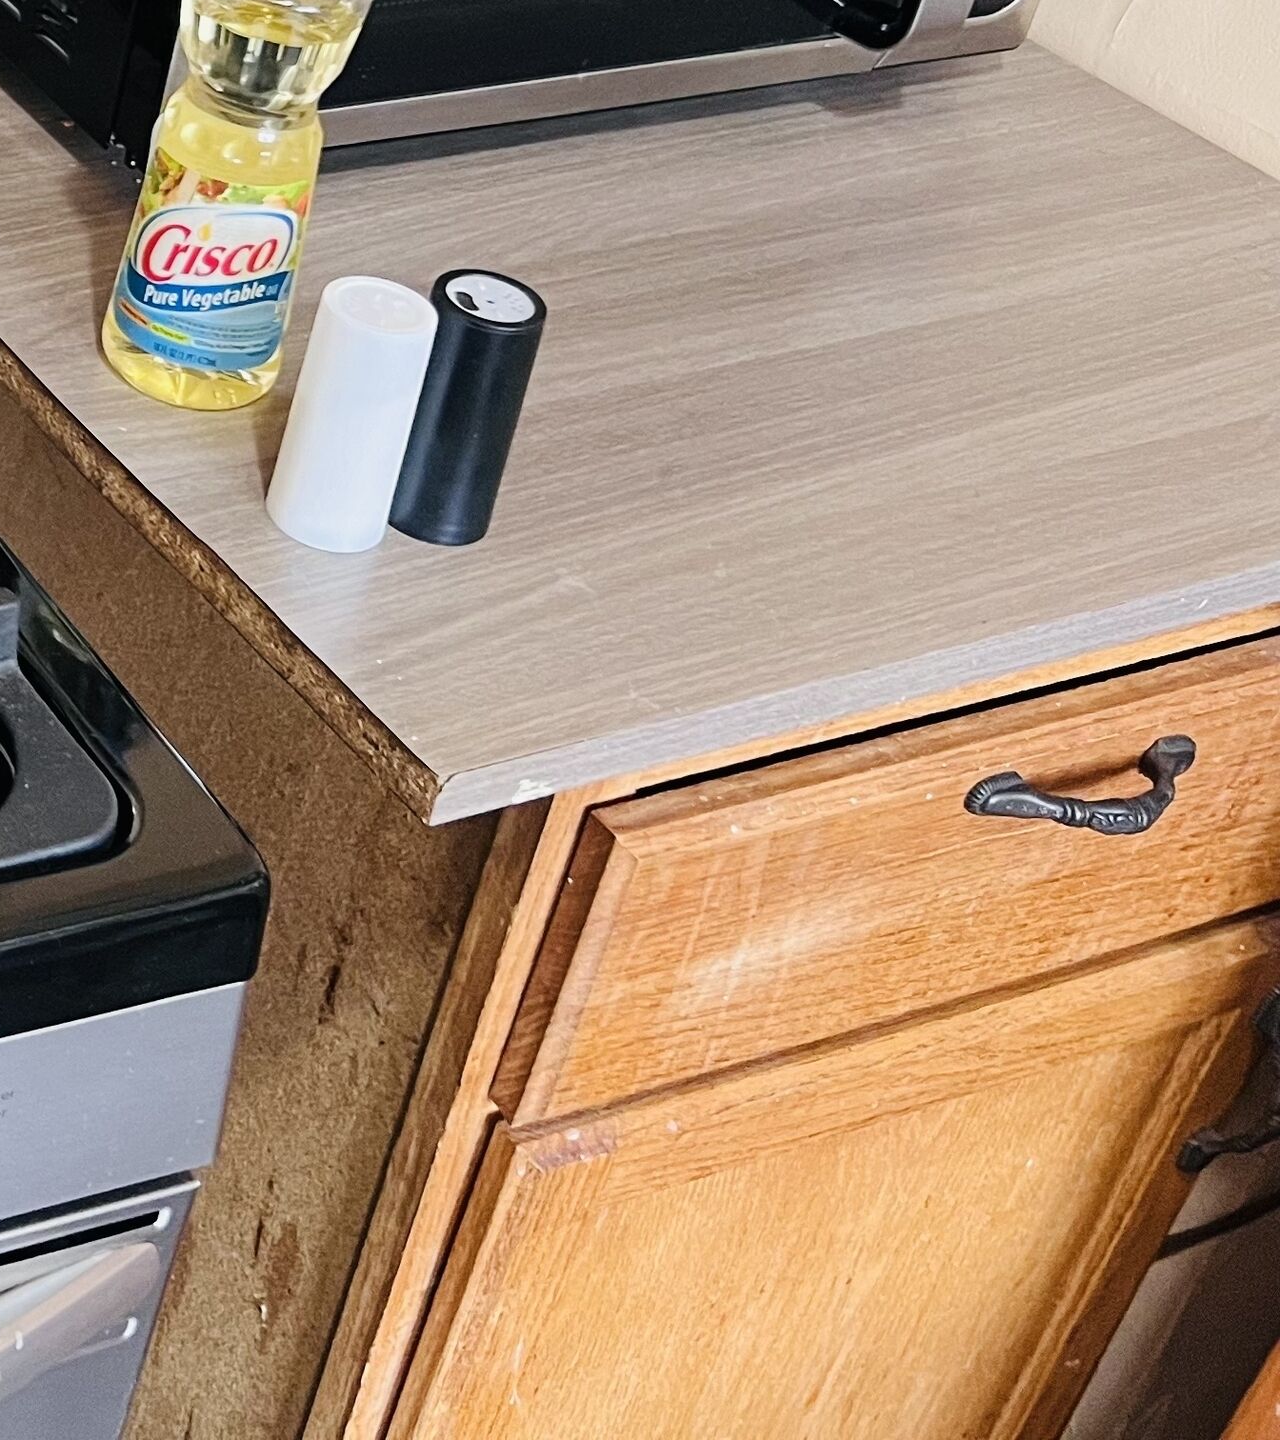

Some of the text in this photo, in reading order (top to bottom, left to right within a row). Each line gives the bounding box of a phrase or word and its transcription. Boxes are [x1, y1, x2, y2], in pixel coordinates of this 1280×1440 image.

[141, 223, 279, 282] Crisco
[143, 283, 179, 307] Pure
[181, 281, 266, 311] Vegetable
